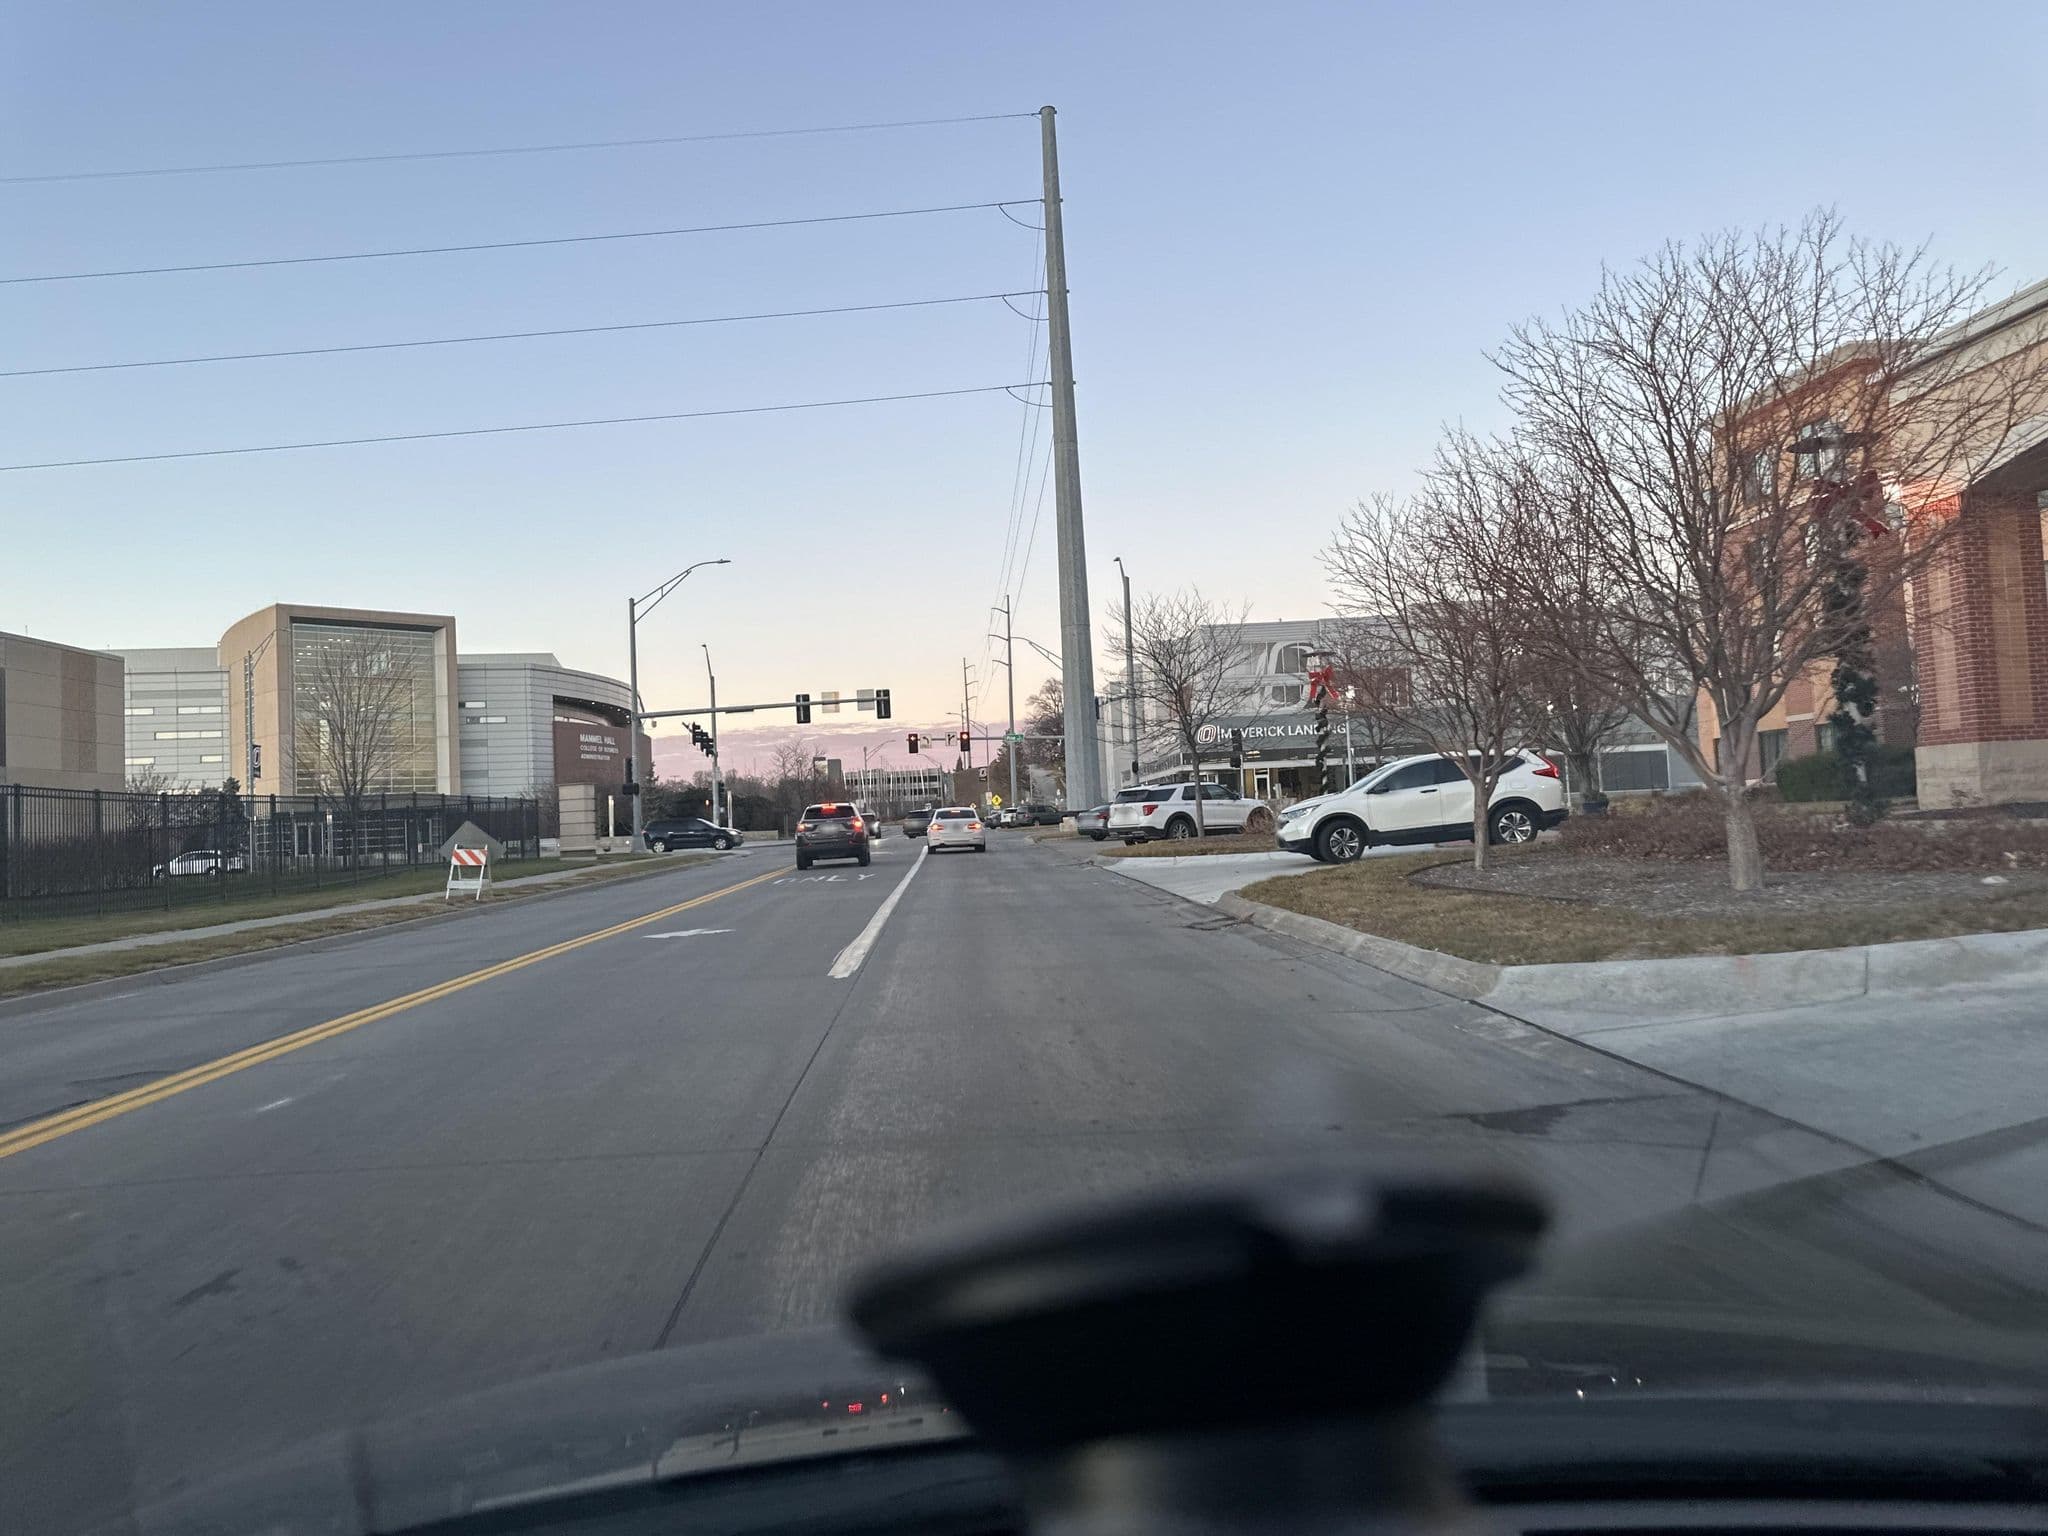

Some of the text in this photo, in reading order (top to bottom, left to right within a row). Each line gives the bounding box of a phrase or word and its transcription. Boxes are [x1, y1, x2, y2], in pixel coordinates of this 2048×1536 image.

[1221, 726, 1286, 738] MVERICK
[604, 736, 616, 746] HALL
[773, 873, 877, 885] ONLY
